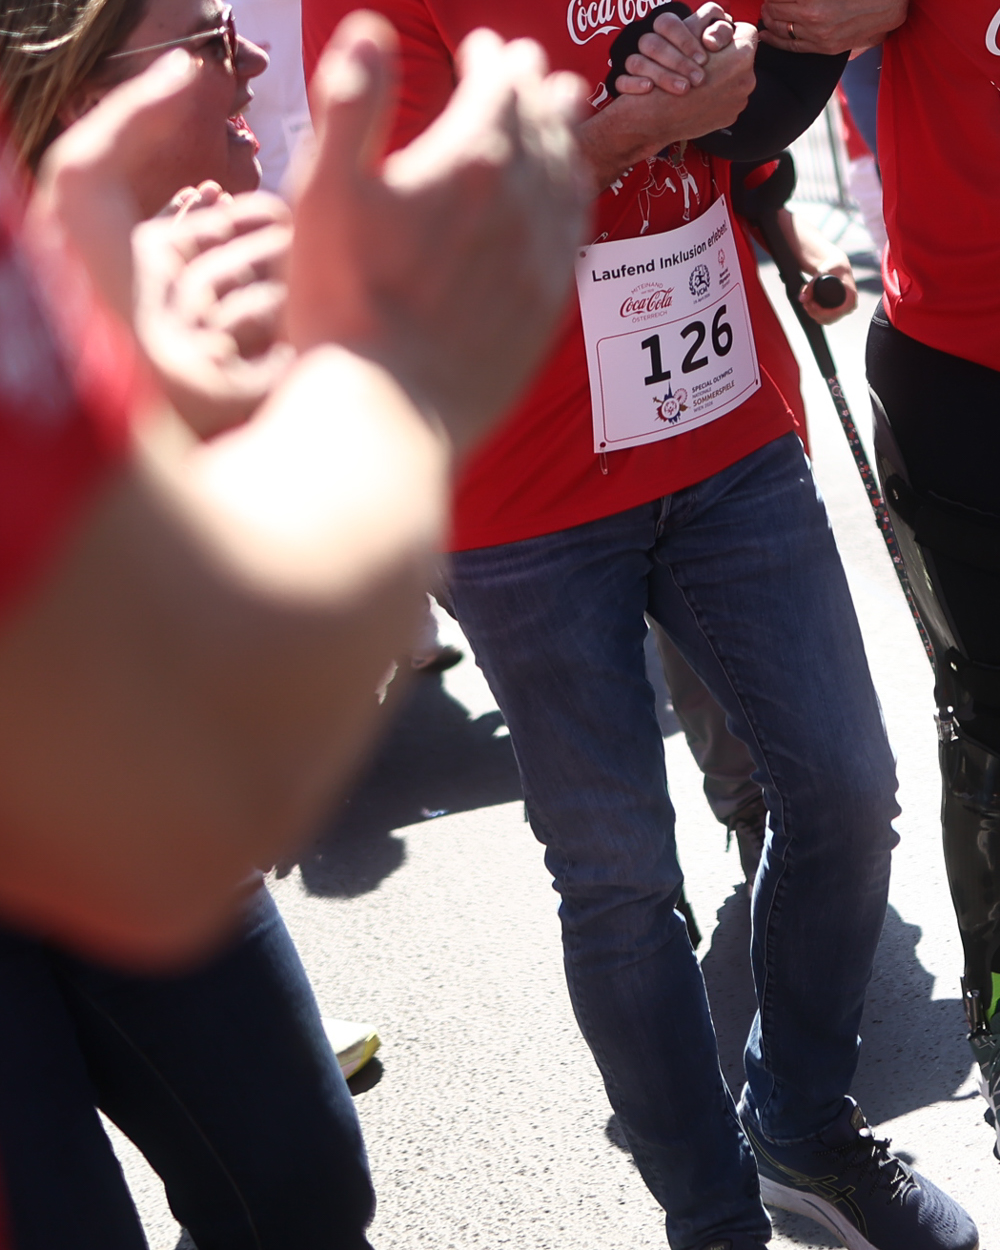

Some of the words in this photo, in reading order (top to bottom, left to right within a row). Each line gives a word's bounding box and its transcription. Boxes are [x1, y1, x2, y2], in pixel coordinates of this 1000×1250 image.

[592, 259, 655, 282] Laufend
[660, 241, 707, 269] Inklusion
[620, 287, 675, 318] Coca-Cola
[641, 304, 733, 386] 126
[692, 380, 712, 393] SPECIAL
[713, 367, 733, 383] OLYMPICS
[692, 380, 735, 407] SOMMERSPIELE
